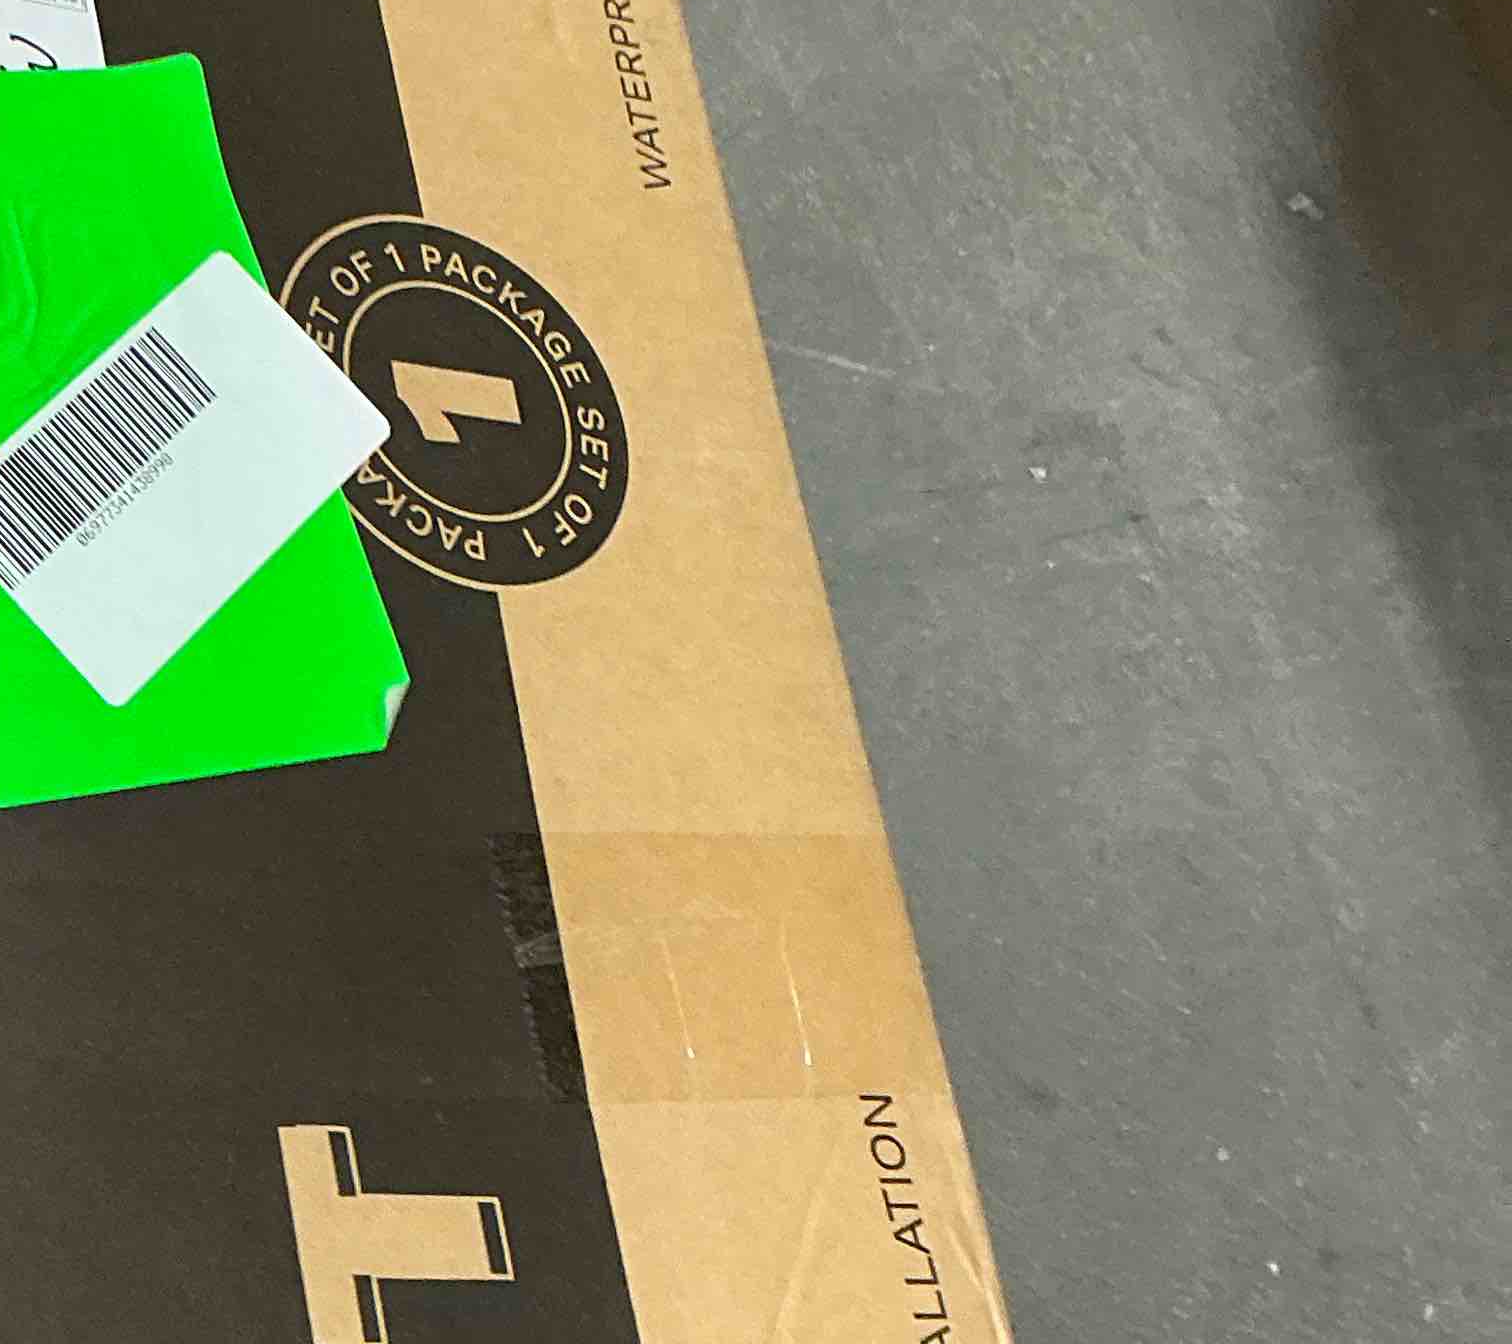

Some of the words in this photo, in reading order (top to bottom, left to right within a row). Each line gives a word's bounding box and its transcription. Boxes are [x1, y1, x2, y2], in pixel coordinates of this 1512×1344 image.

[304, 296, 340, 354] ET
[329, 250, 376, 296] OF
[383, 242, 406, 273] 1
[420, 243, 591, 388] PACKAGE
[390, 359, 522, 444] 1
[576, 406, 609, 491] SET
[357, 462, 488, 561] PACKA
[521, 527, 546, 558] 1
[552, 494, 593, 547] OF
